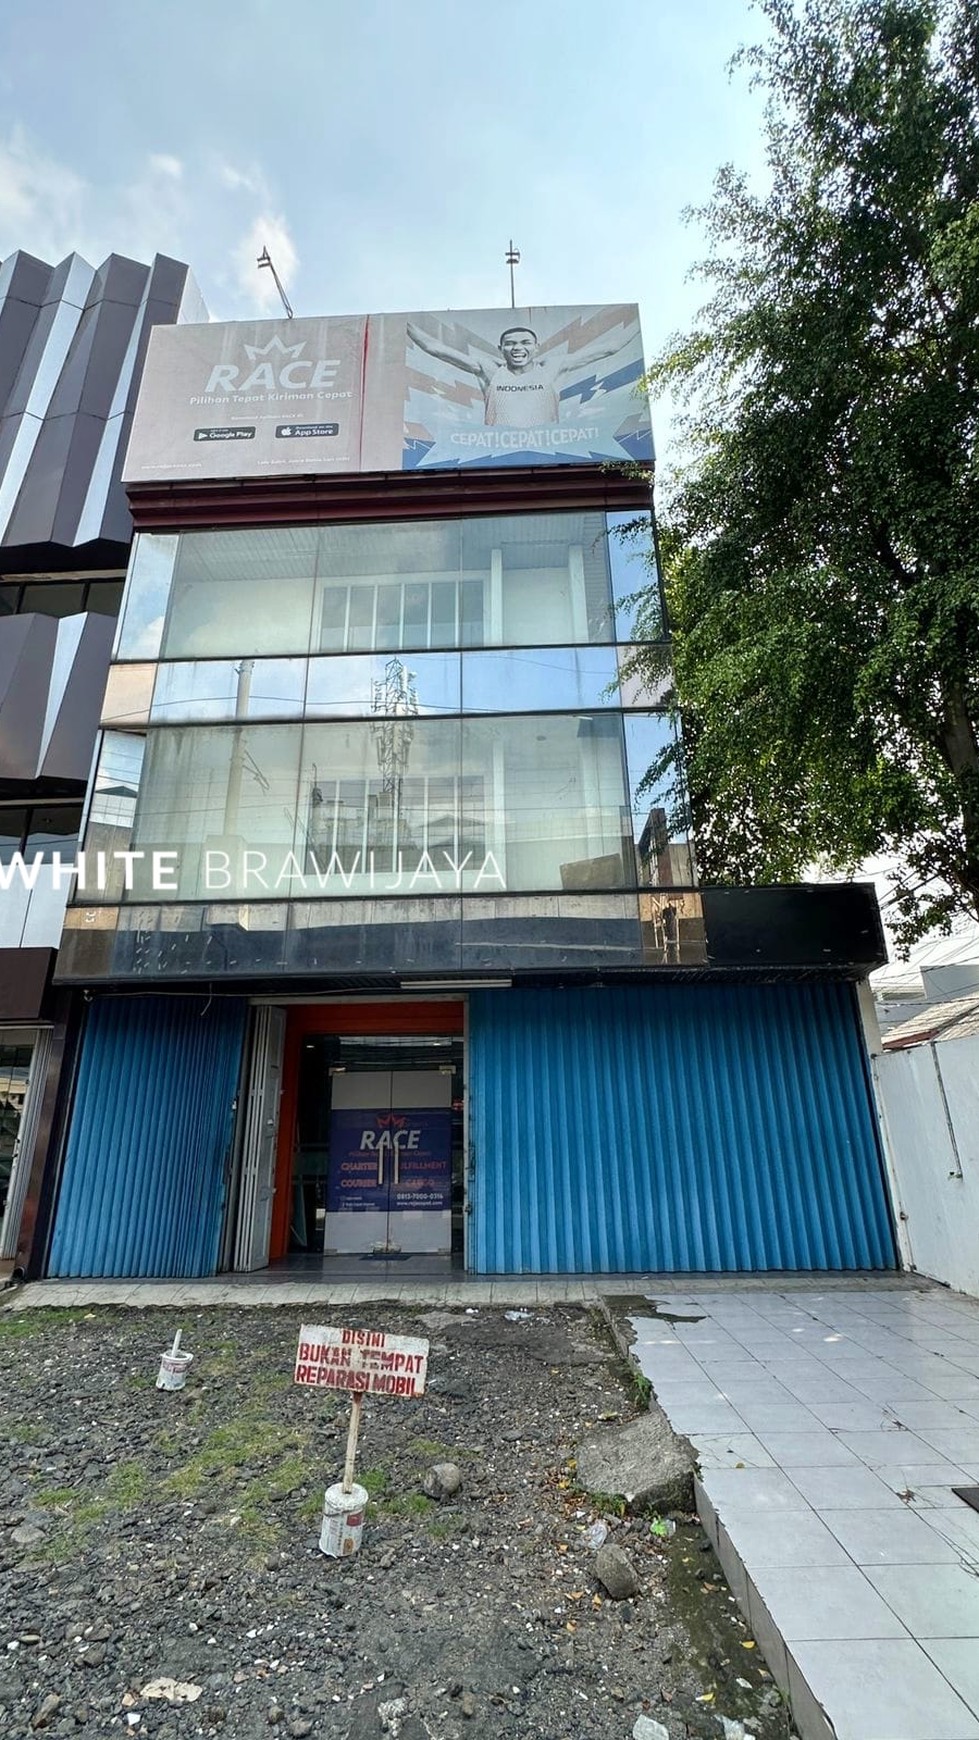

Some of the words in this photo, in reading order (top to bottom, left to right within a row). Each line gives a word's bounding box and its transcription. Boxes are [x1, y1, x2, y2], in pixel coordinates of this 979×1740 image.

[204, 359, 341, 393] RACE
[496, 384, 544, 392] INDONESIA
[190, 396, 229, 405] Pilihan
[233, 394, 265, 404] Tepat
[268, 392, 314, 401] Kiriman
[317, 390, 353, 400] Cepat
[295, 429, 312, 437] App
[360, 1130, 421, 1150] RACE
[342, 1330, 385, 1347] DISINI
[300, 1343, 352, 1367] BUKAN
[360, 1349, 424, 1374] TEMPAT
[296, 1364, 370, 1391] REPARASI
[373, 1373, 416, 1396] MOBIL
